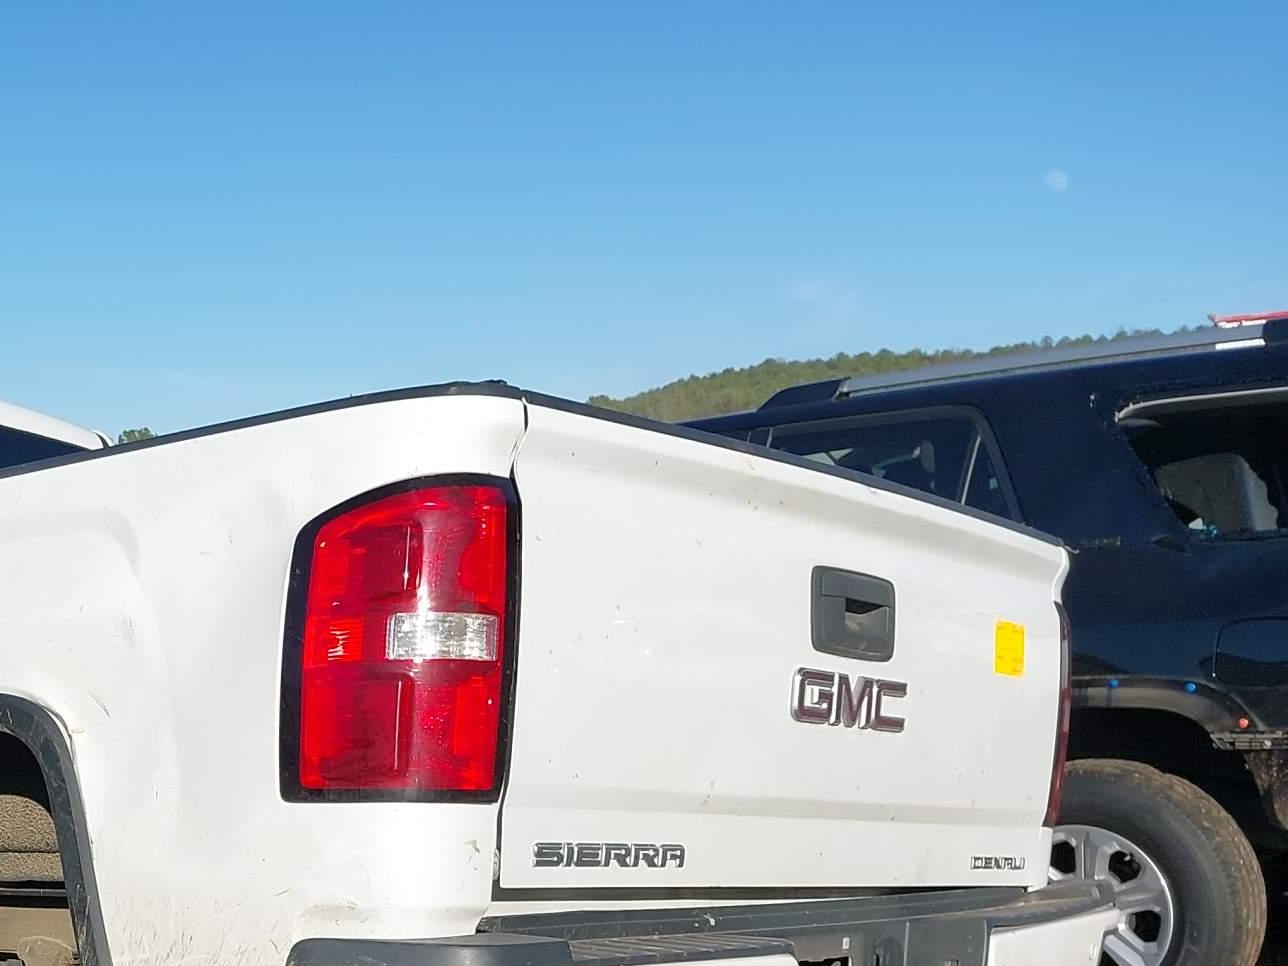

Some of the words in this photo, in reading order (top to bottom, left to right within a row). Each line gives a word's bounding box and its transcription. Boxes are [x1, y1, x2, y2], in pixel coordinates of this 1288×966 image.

[791, 667, 908, 733] GMC
[532, 842, 686, 868] SIERRA
[970, 856, 1026, 871] DENALI
